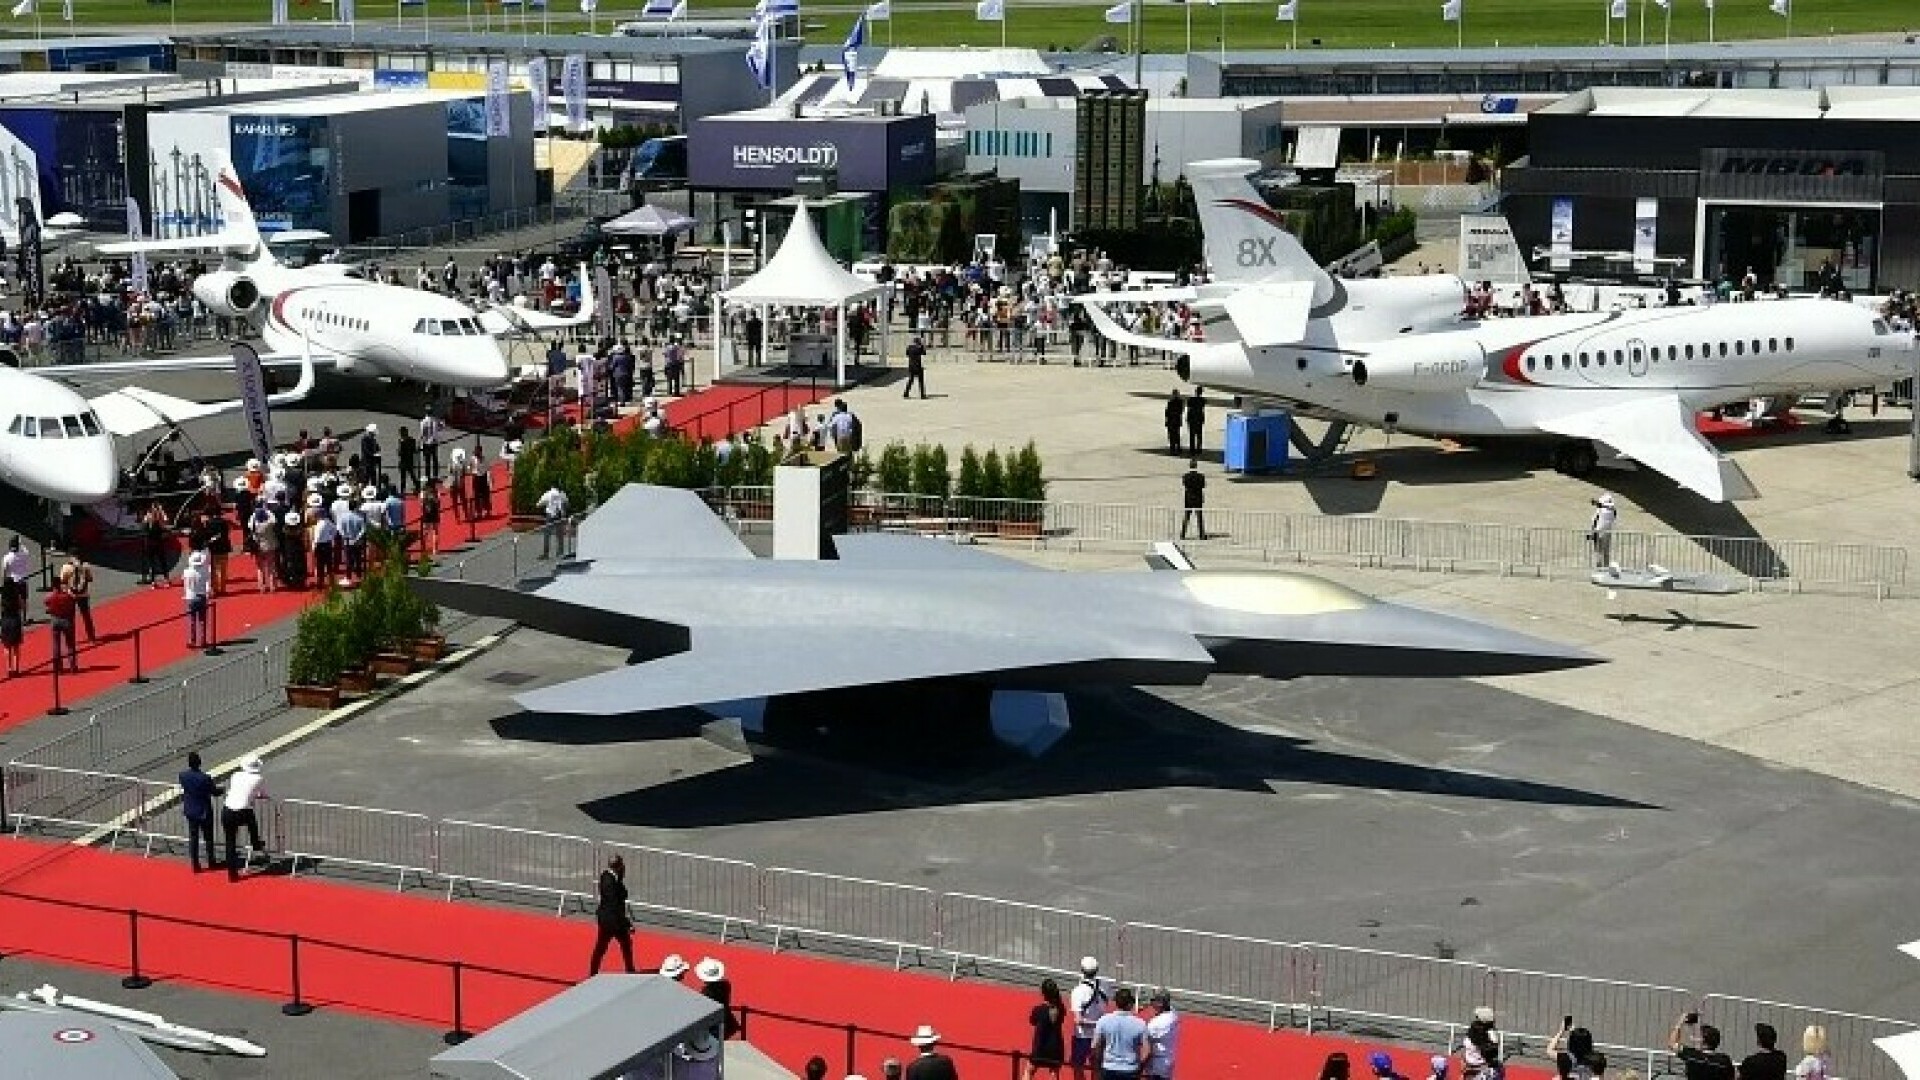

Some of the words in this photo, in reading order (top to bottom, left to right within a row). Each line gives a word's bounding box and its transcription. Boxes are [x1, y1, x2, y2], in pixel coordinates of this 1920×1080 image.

[733, 145, 834, 164] HENSOLDT
[1719, 157, 1864, 176] MBDA
[1237, 236, 1277, 266] 8X
